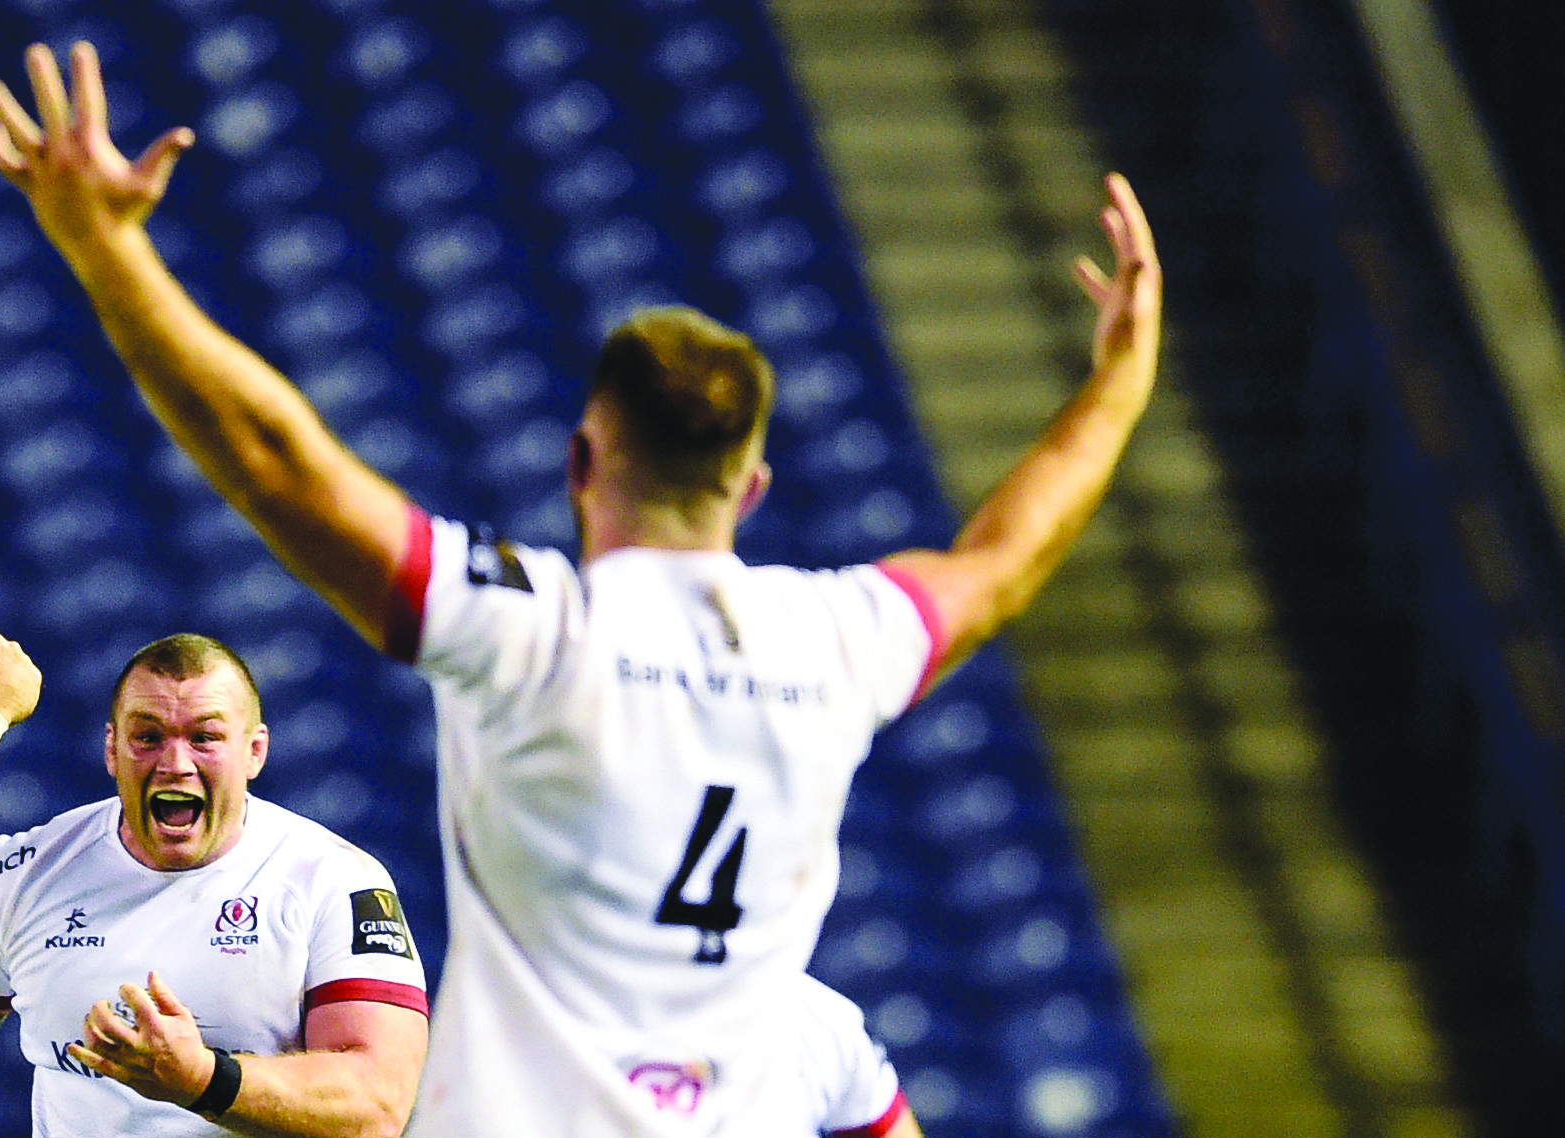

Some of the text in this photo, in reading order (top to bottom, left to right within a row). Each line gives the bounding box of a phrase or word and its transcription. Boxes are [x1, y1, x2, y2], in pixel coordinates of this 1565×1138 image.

[655, 785, 747, 963] 4
[45, 935, 105, 949] KUKRI
[210, 934, 258, 946] ULSTER
